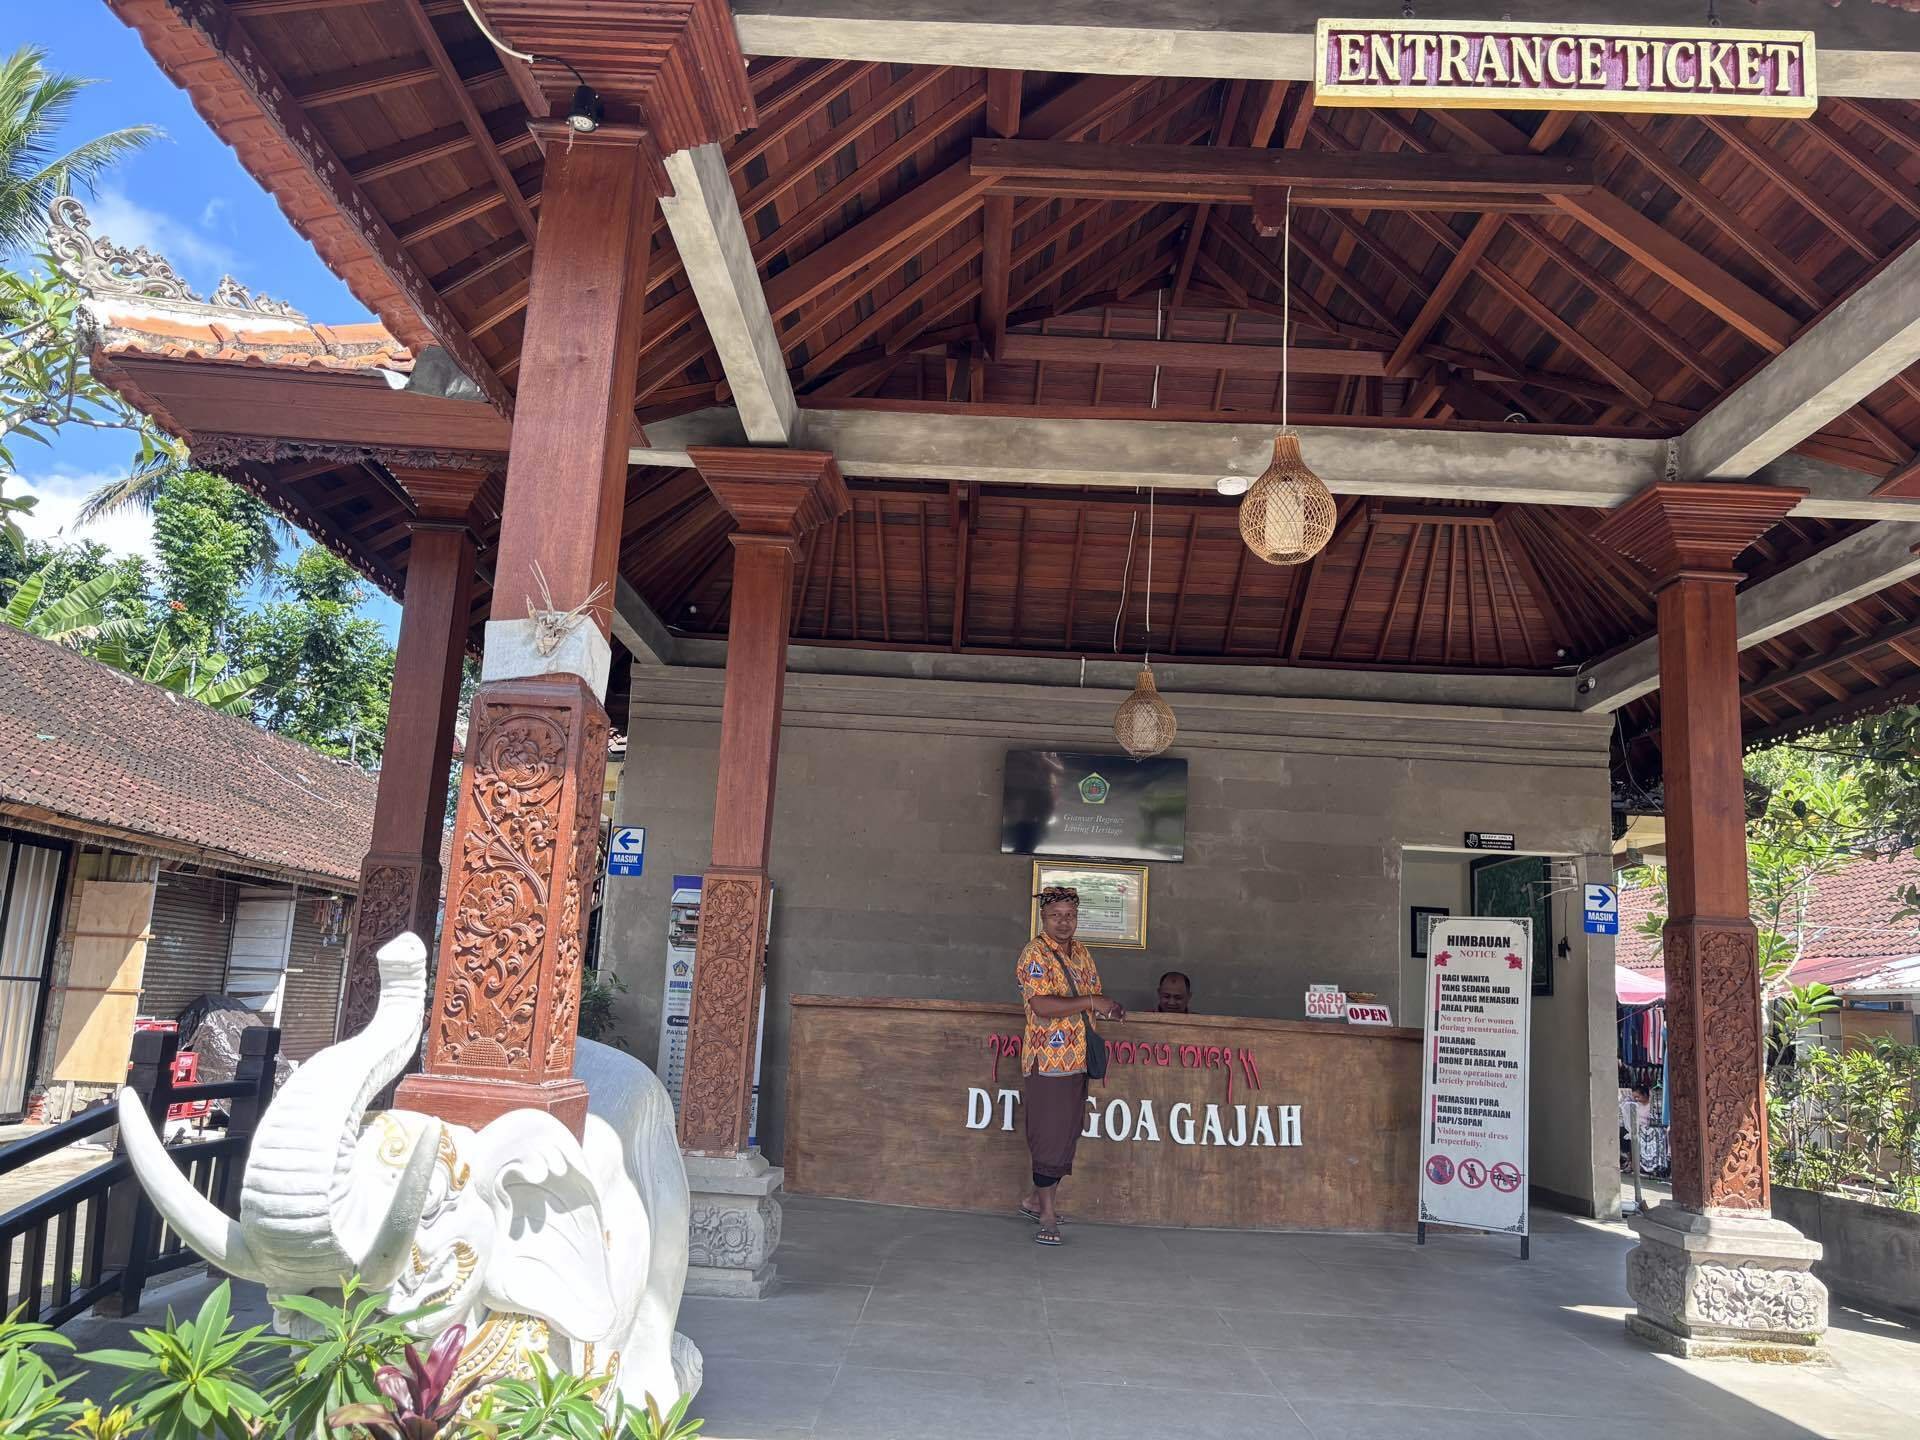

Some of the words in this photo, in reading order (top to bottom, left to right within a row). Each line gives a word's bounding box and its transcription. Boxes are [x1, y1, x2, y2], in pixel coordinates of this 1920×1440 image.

[1338, 33, 1607, 86] ENTRANCE
[1615, 40, 1799, 92] TICKET
[613, 854, 638, 863] MASUK
[620, 866, 629, 874] IN
[1587, 912, 1614, 921] MASUK
[1596, 924, 1605, 932] IN
[1447, 935, 1510, 947] HIMBAUAN
[1460, 950, 1496, 958] NOTICE
[1442, 974, 1460, 982] BAGI
[1461, 975, 1489, 983] WANITA
[1441, 984, 1460, 992] YANG
[1462, 985, 1490, 993] SEDANG
[1491, 986, 1510, 994] HAID
[1309, 993, 1343, 1003] CASH
[1441, 994, 1477, 1002] DILARANG
[1479, 996, 1519, 1004] MEMASUKI
[1308, 1004, 1344, 1014] ONLY
[1441, 1004, 1462, 1012] AREAL
[1464, 1005, 1484, 1013] PURA
[1349, 1007, 1387, 1021] OPEN
[1453, 1016, 1472, 1024] entry
[1474, 1015, 1486, 1023] for
[1440, 1024, 1465, 1033] during
[1467, 1025, 1519, 1035] menstruation.
[1439, 1036, 1475, 1045] DILARANG
[1439, 1046, 1506, 1058] MENGOPERASIKAN
[1439, 1056, 1463, 1065] DRONE
[1464, 1058, 1472, 1066] DI
[1473, 1059, 1496, 1067] AREAL
[1497, 1060, 1518, 1069] PURA
[1439, 1067, 1462, 1075] Drone
[1463, 1069, 1503, 1079] operations
[1438, 1077, 1464, 1086] strictly
[1466, 1079, 1508, 1089] prohibited.
[1438, 1095, 1477, 1105] MEMASUKI
[1479, 1098, 1499, 1107] PURA
[1437, 1105, 1462, 1115] HARUS
[1464, 1108, 1510, 1119] BERPAKAIAN
[966, 1088, 1020, 1131] DT
[1169, 1103, 1303, 1147] GAJAH
[1437, 1115, 1482, 1127] RAPI/SOPAN
[1437, 1127, 1466, 1136] Visitors
[1467, 1130, 1486, 1138] must
[1488, 1131, 1508, 1140] dress
[1437, 1138, 1482, 1148] respectfully.
